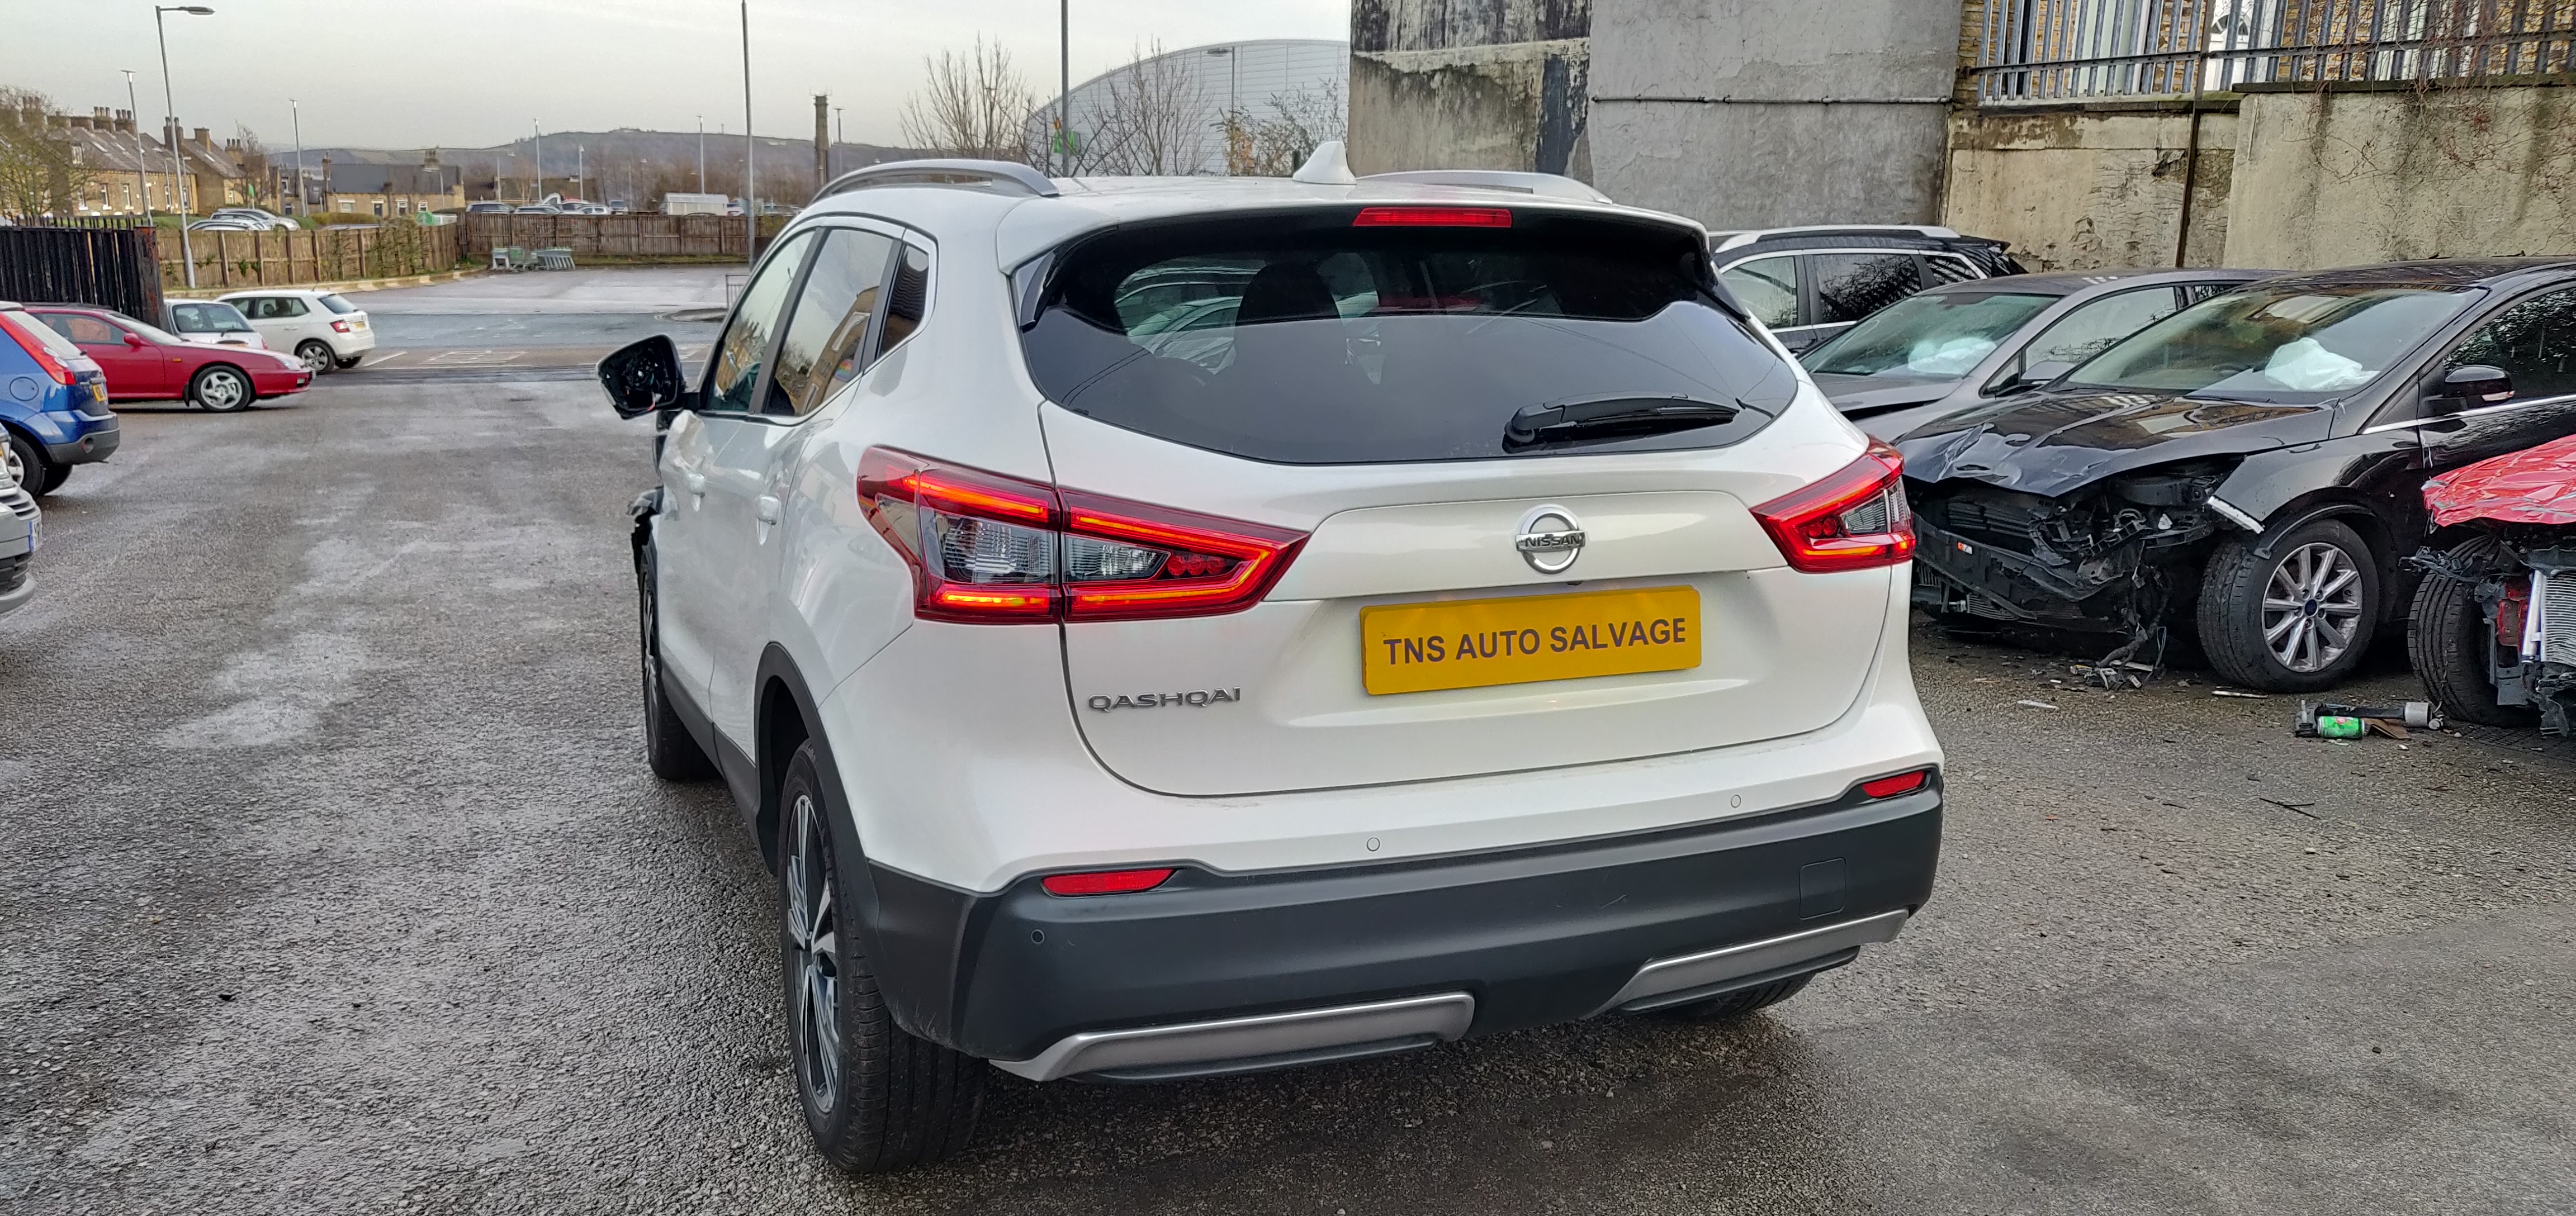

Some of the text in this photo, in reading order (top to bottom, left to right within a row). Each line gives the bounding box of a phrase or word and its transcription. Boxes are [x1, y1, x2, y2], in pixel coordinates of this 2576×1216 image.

[1525, 535, 1580, 548] NISSAN
[1383, 618, 1685, 665] TNS AUTO SALVAGE
[1088, 686, 1240, 712] QASHQAI
